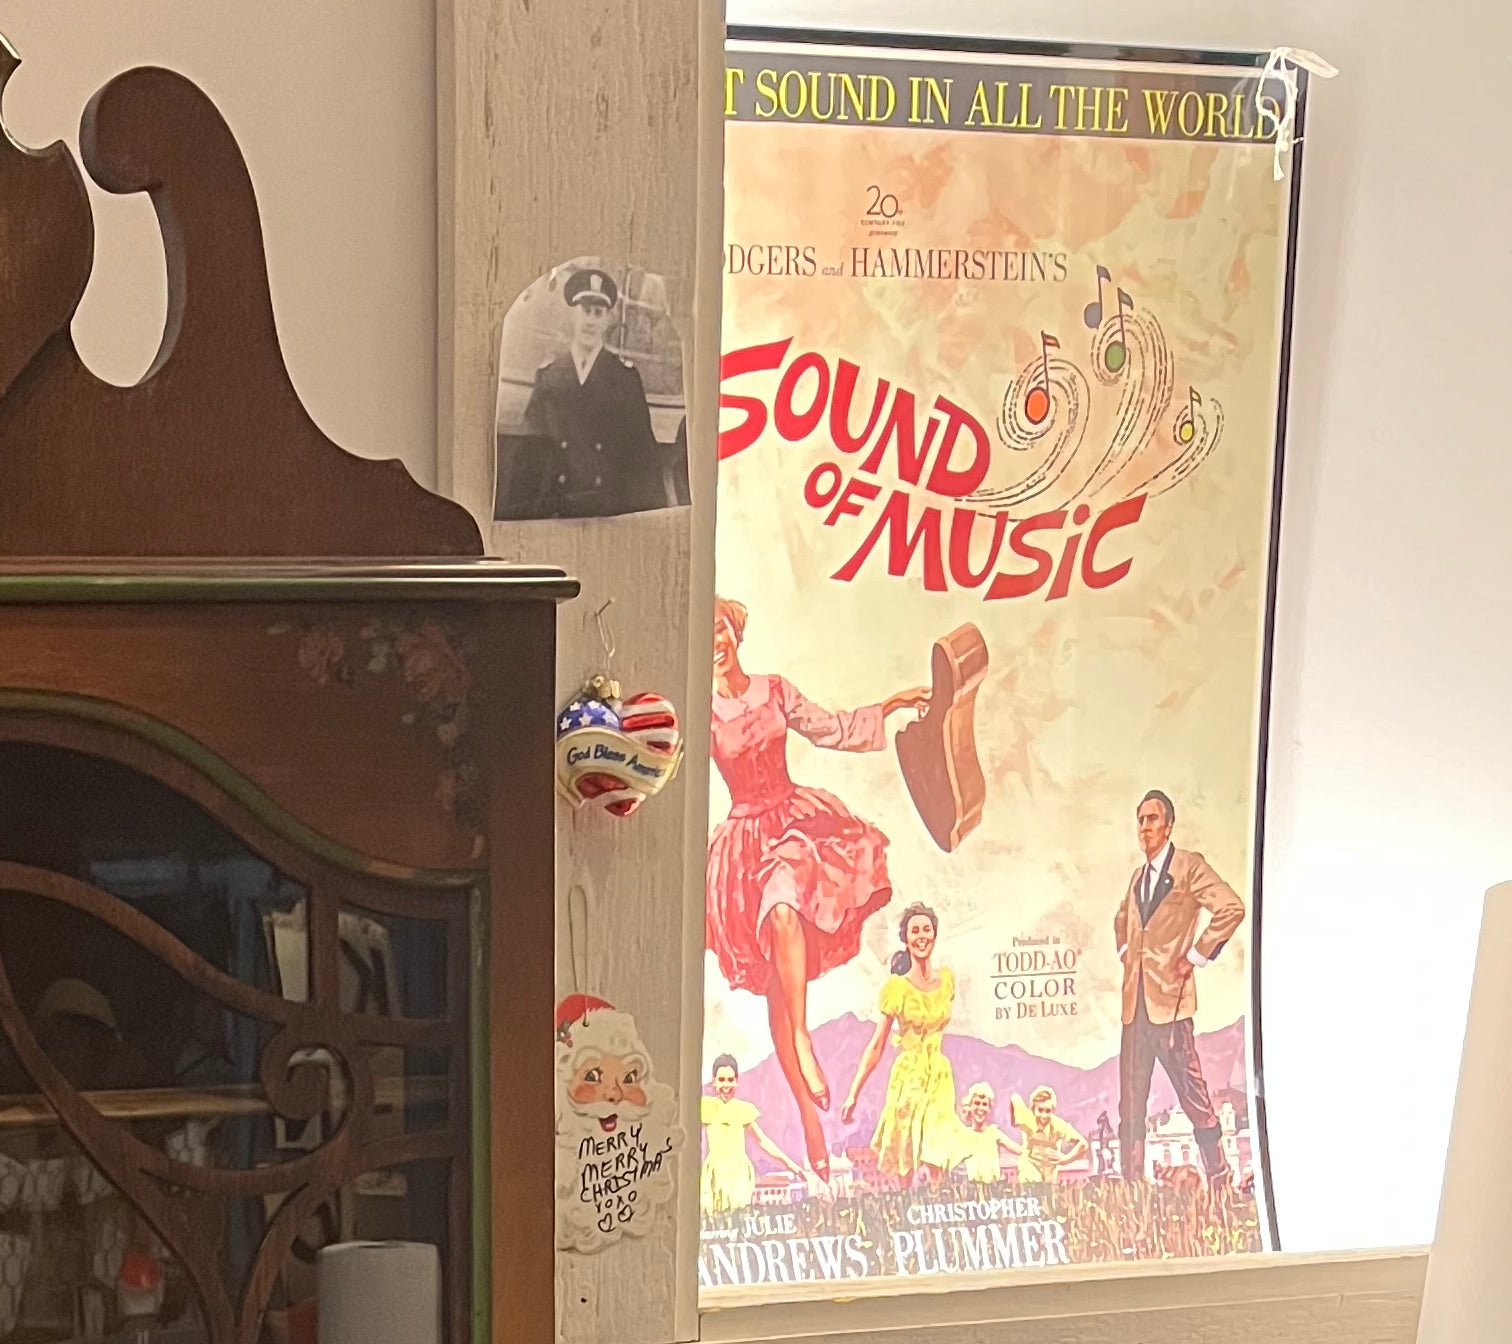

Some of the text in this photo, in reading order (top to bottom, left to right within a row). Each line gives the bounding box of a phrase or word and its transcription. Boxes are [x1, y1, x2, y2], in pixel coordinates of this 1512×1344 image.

[755, 68, 897, 121] SOUND
[907, 76, 954, 125] IN
[964, 81, 1042, 129] ALL
[1049, 84, 1130, 133] THE
[850, 246, 1068, 283] HAMMERSTEIN'S
[718, 336, 991, 498] SOUND
[804, 461, 883, 527] OF
[567, 746, 591, 765] God
[994, 977, 1076, 1001] COLOR
[995, 1006, 1012, 1020] BY
[1041, 1000, 1078, 1018] LUXE
[578, 1123, 643, 1160] MERRY
[581, 1142, 649, 1182] MERRY
[742, 1213, 798, 1239] JULIE
[905, 1196, 1042, 1225] CHRISTOPHER
[697, 1234, 870, 1289] ANDREWS
[891, 1219, 1071, 1277] PLUMMER
